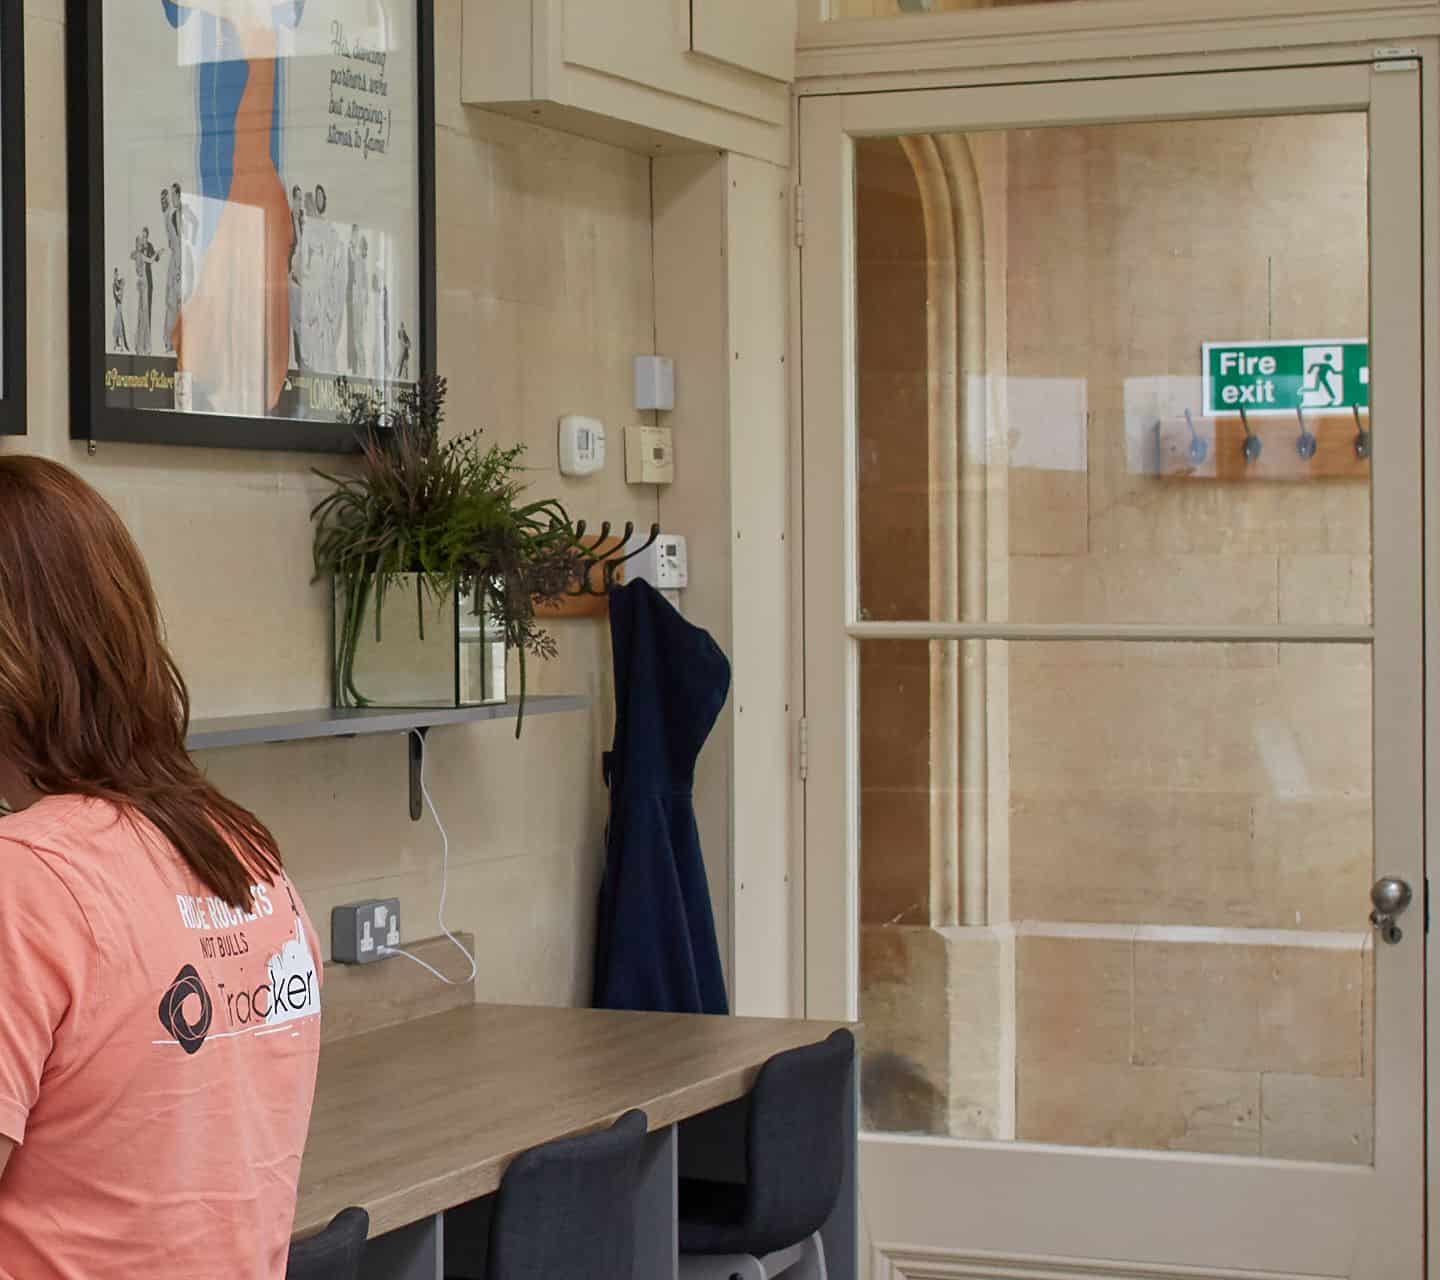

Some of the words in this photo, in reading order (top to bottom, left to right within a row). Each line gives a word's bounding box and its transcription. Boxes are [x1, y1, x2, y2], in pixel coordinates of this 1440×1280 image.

[1220, 351, 1277, 376] Fire
[1221, 378, 1276, 404] exit
[175, 894, 210, 929] RIDE
[199, 936, 217, 959] NOT
[217, 931, 249, 958] BULLS
